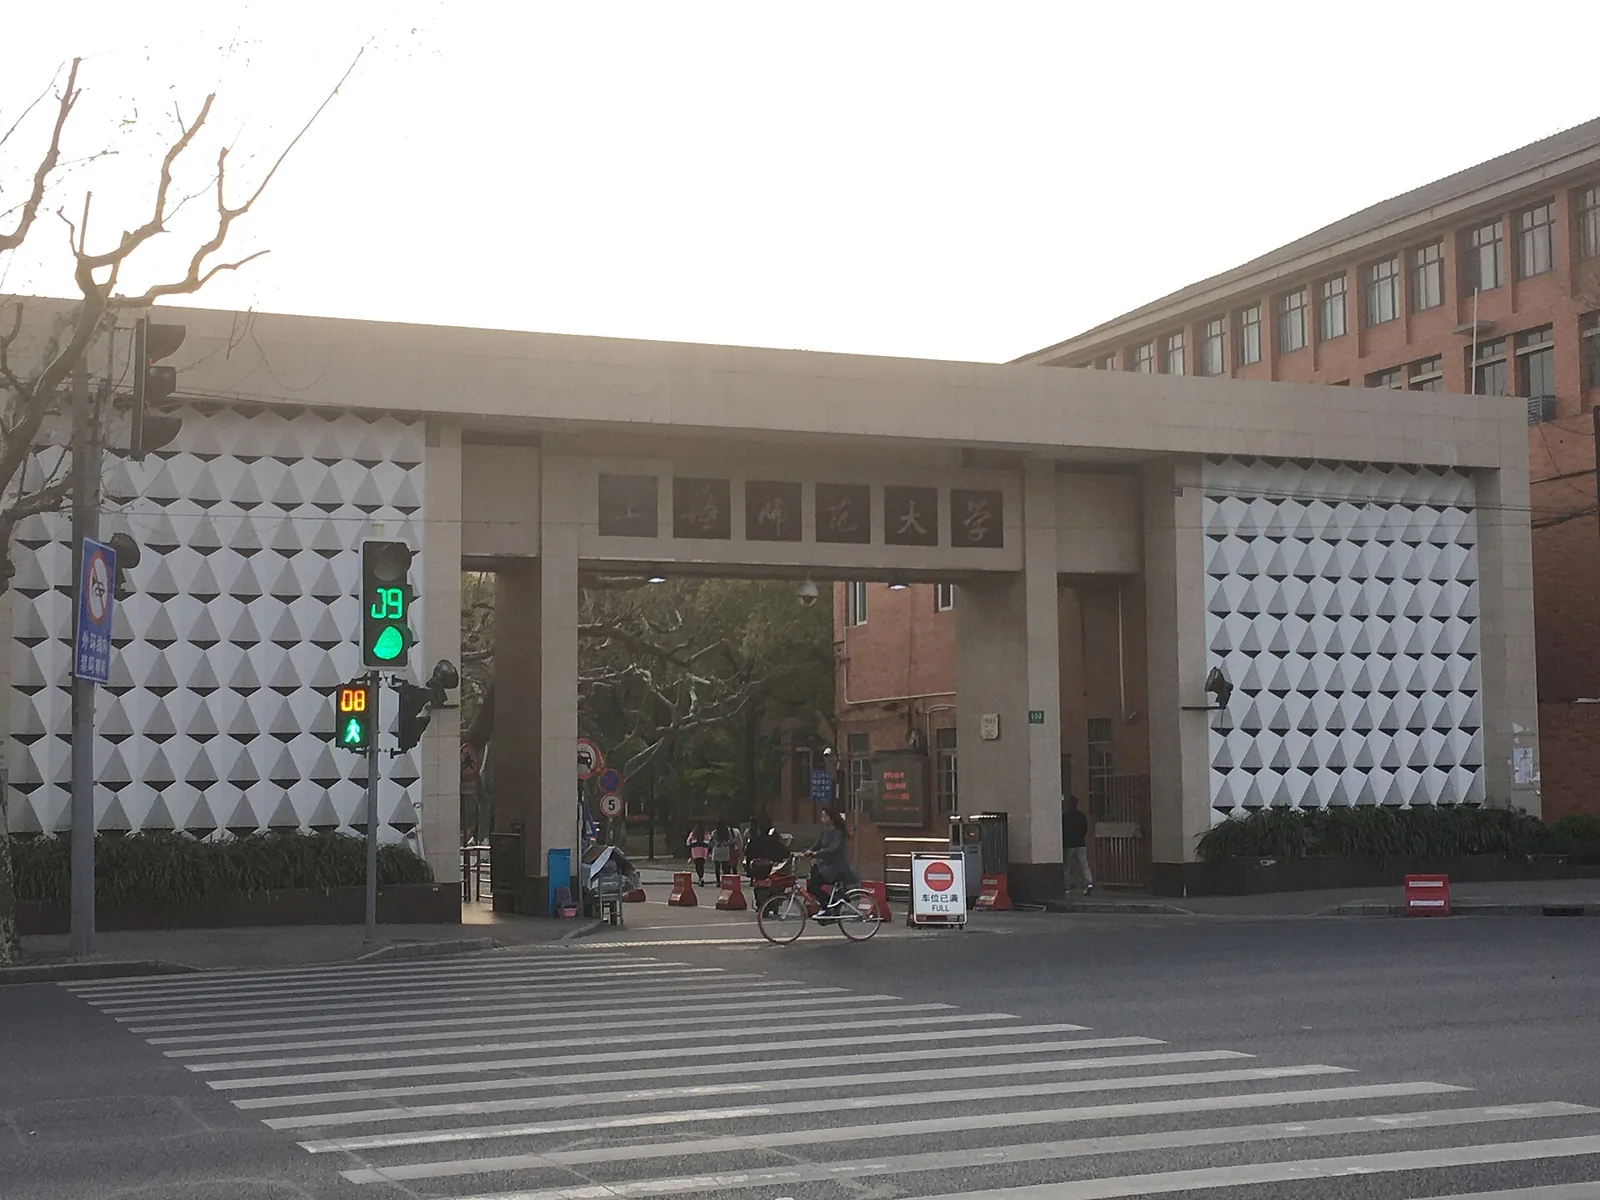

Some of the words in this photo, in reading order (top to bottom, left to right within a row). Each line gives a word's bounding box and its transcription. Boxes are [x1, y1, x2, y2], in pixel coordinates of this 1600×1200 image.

[341, 690, 366, 712] 08
[608, 799, 616, 811] 5
[921, 893, 959, 903] 车位已满
[931, 904, 950, 912] FULL
